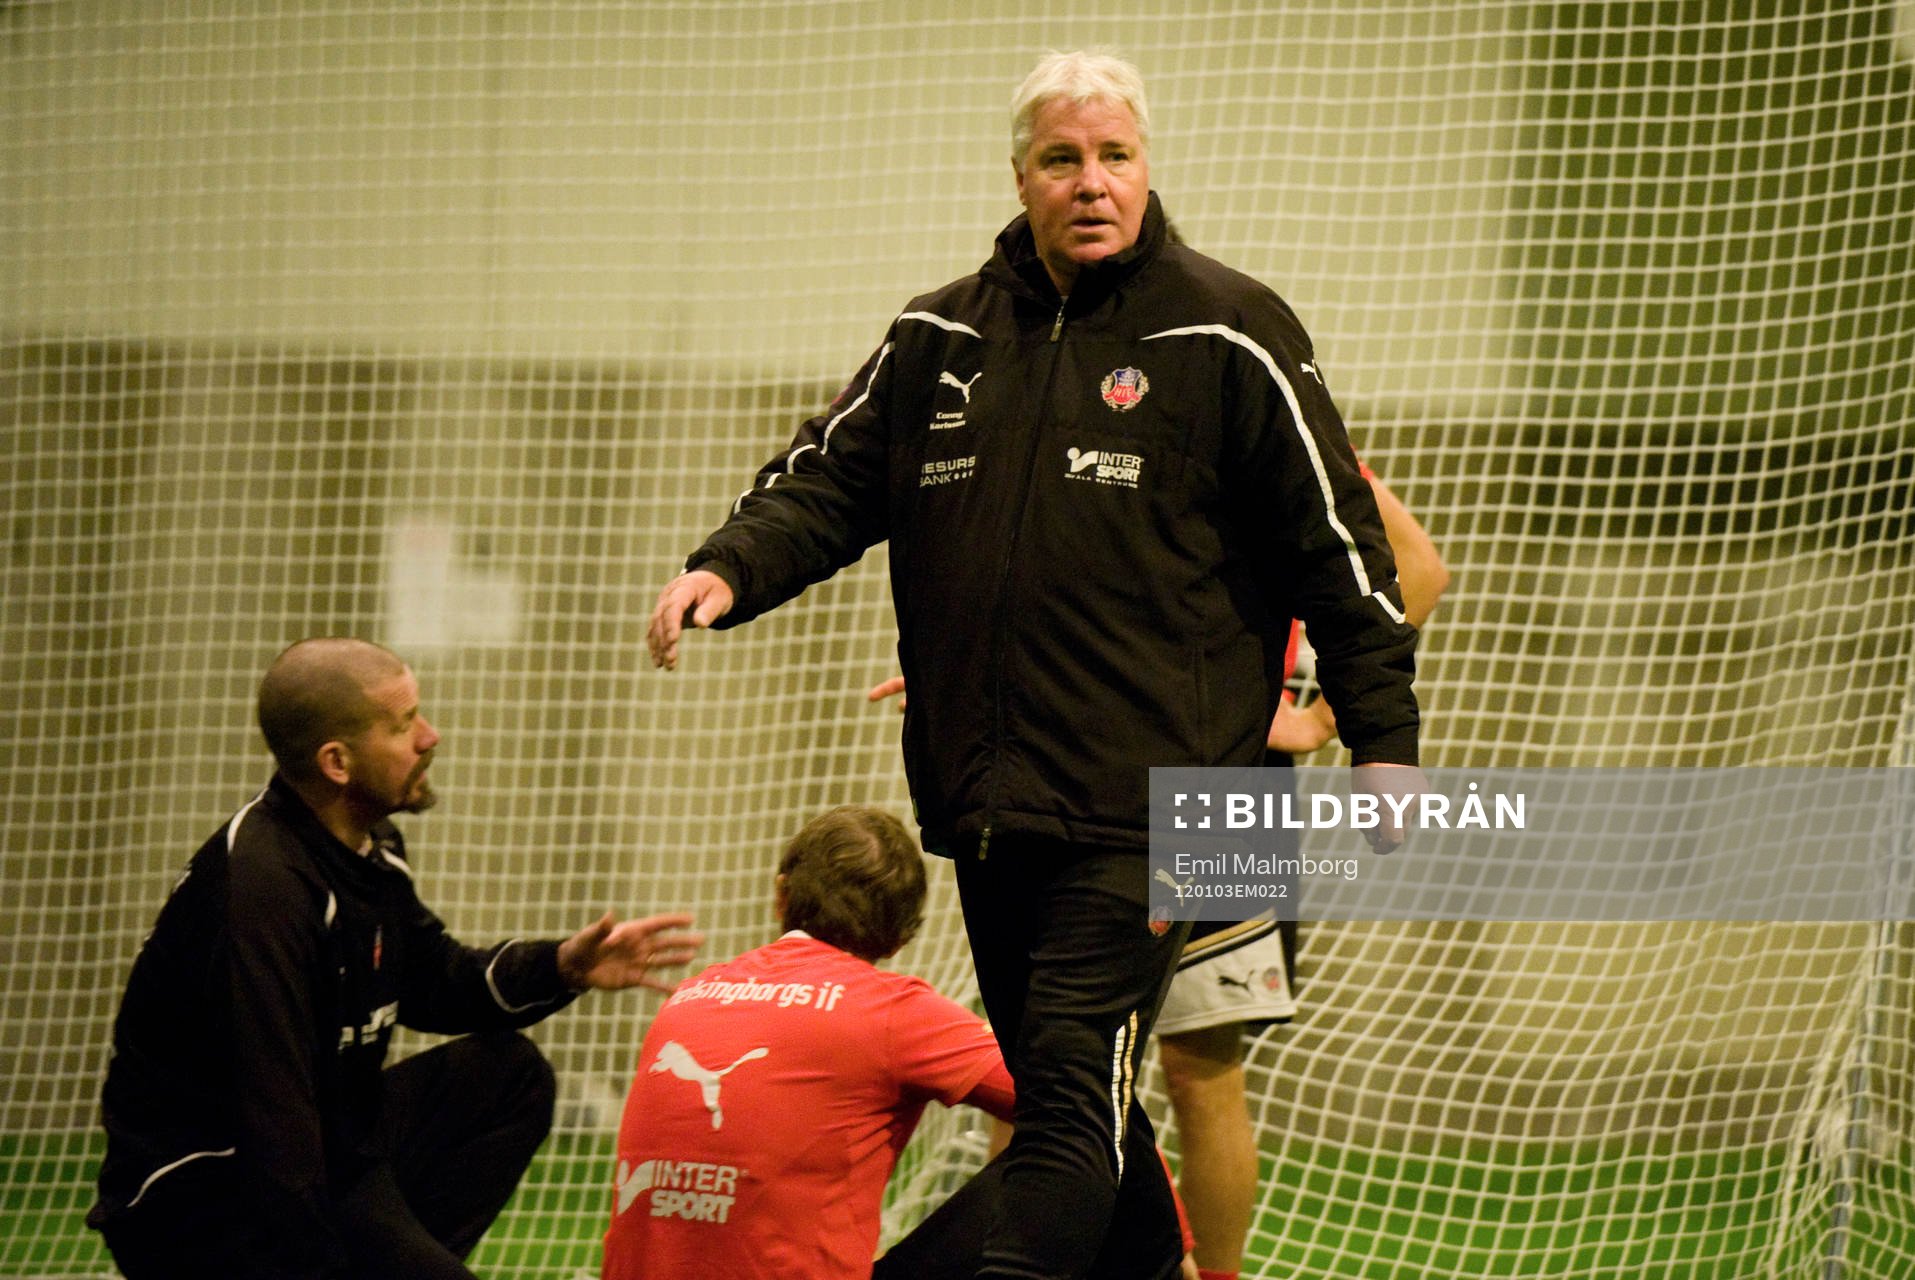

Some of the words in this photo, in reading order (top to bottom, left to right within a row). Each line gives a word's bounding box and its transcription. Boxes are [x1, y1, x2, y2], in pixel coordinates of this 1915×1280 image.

[1096, 464, 1141, 482] SPORT
[1099, 451, 1141, 469] INTER
[814, 981, 845, 1012] if
[654, 1159, 738, 1193] INTER
[650, 1189, 737, 1224] SPORT
